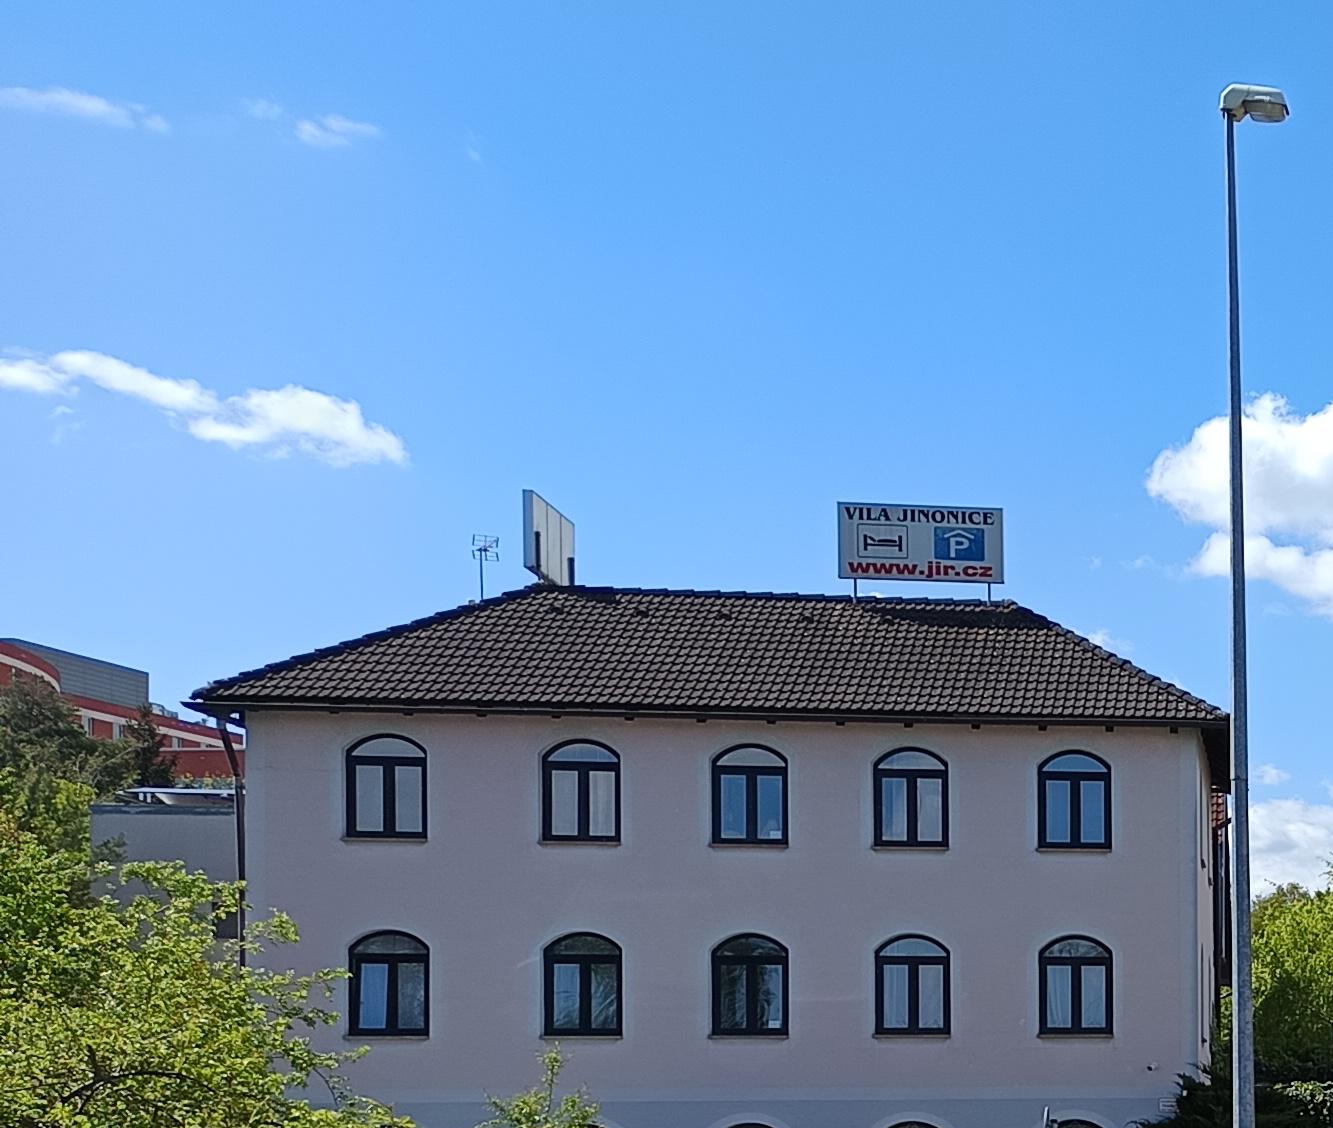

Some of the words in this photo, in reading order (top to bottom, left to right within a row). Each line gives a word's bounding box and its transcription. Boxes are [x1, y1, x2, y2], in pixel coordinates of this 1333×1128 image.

[844, 506, 892, 521] VILA
[896, 508, 995, 526] JINONICE
[949, 537, 970, 558] P
[848, 561, 993, 578] www.jir.cz
